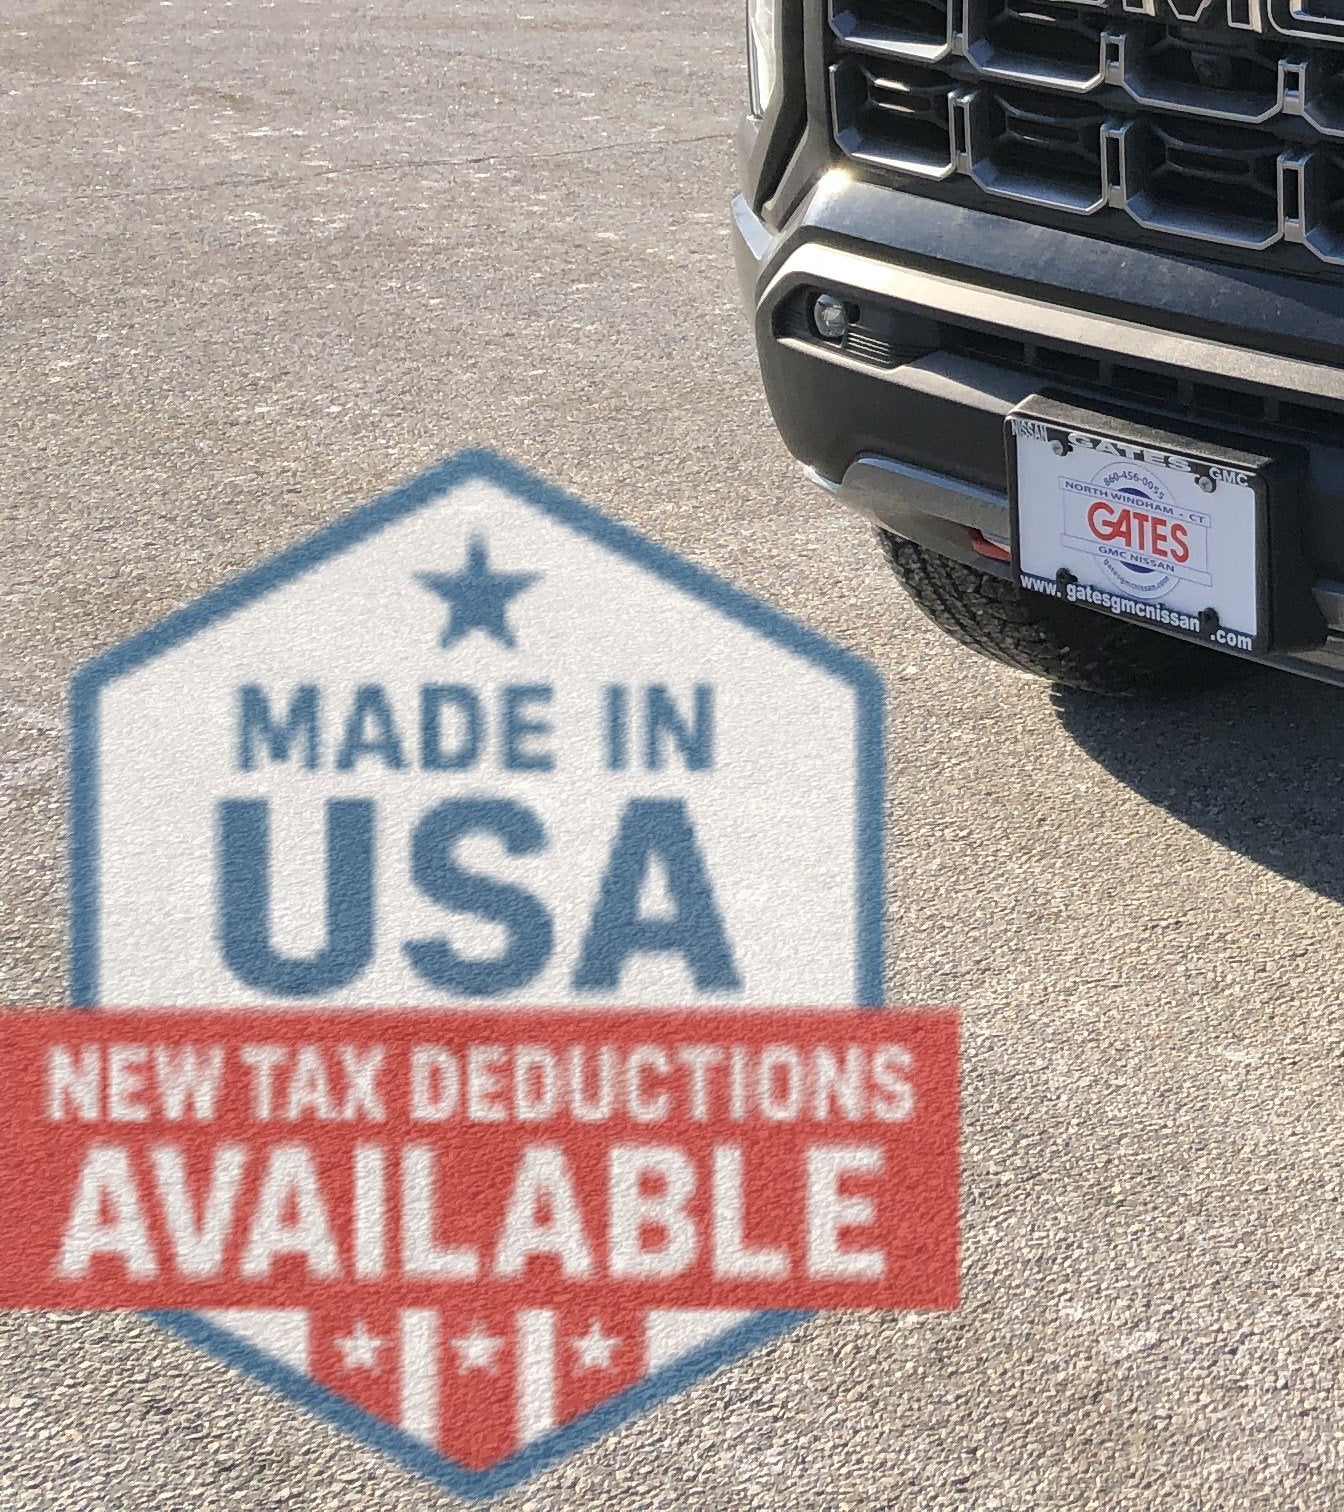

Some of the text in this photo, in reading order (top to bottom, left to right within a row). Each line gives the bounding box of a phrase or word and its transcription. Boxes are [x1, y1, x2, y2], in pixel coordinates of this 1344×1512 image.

[1010, 419, 1249, 487] NISSAN GATES GMC
[1065, 480, 1109, 499] NORTH
[1111, 492, 1175, 516] WINDHAM
[1188, 513, 1206, 524] CT
[1087, 501, 1190, 564] GATES
[1098, 546, 1175, 573] GMC NISSAN
